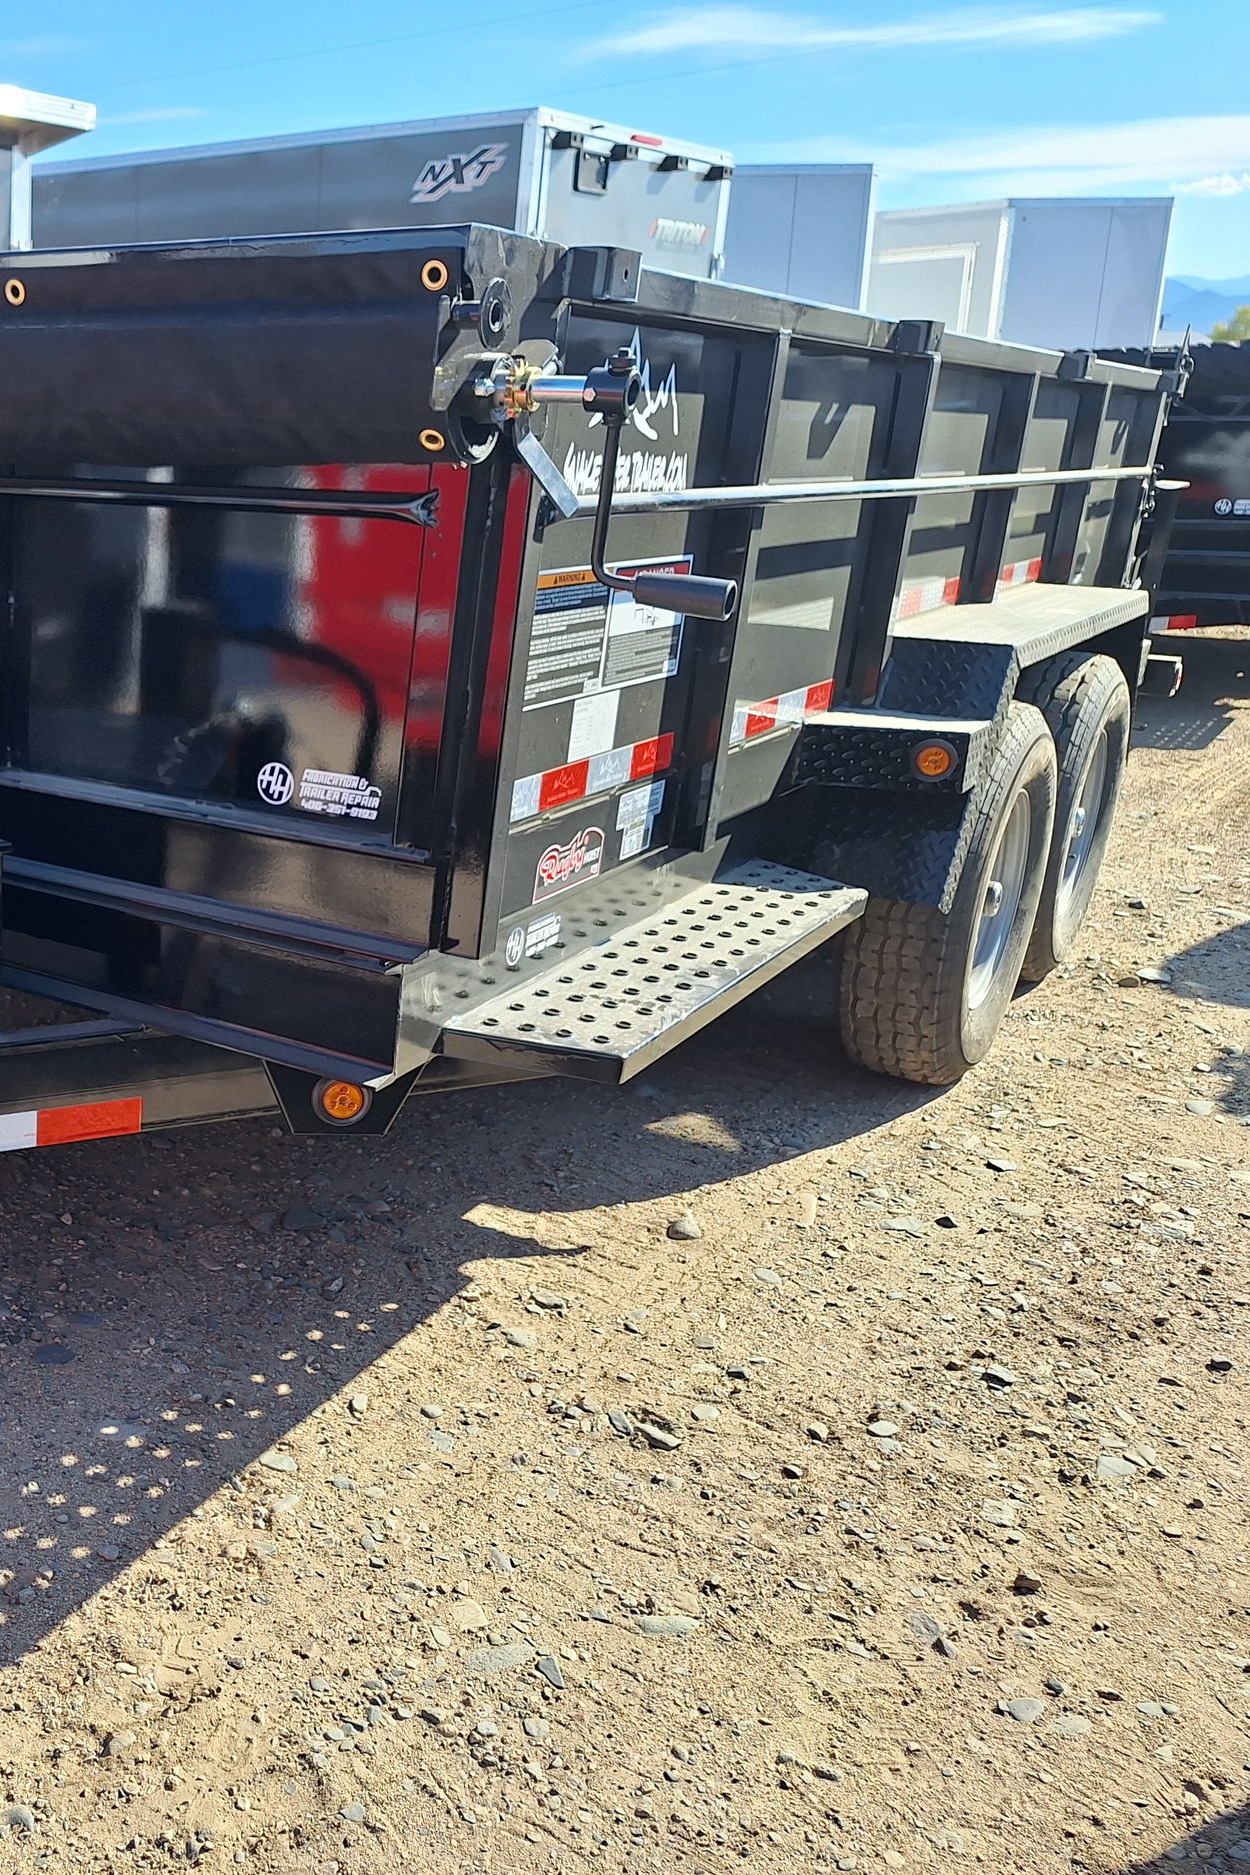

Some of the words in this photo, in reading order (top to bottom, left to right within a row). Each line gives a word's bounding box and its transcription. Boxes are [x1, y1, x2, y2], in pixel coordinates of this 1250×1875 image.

[409, 142, 510, 203] NXT
[655, 218, 706, 245] TRITON
[558, 573, 581, 583] WARNING
[302, 769, 360, 790] FABRICATION
[299, 784, 342, 802] TRAILER
[340, 794, 381, 809] REPAIR
[540, 842, 586, 886] Rugby
[584, 847, 600, 864] HOIST
